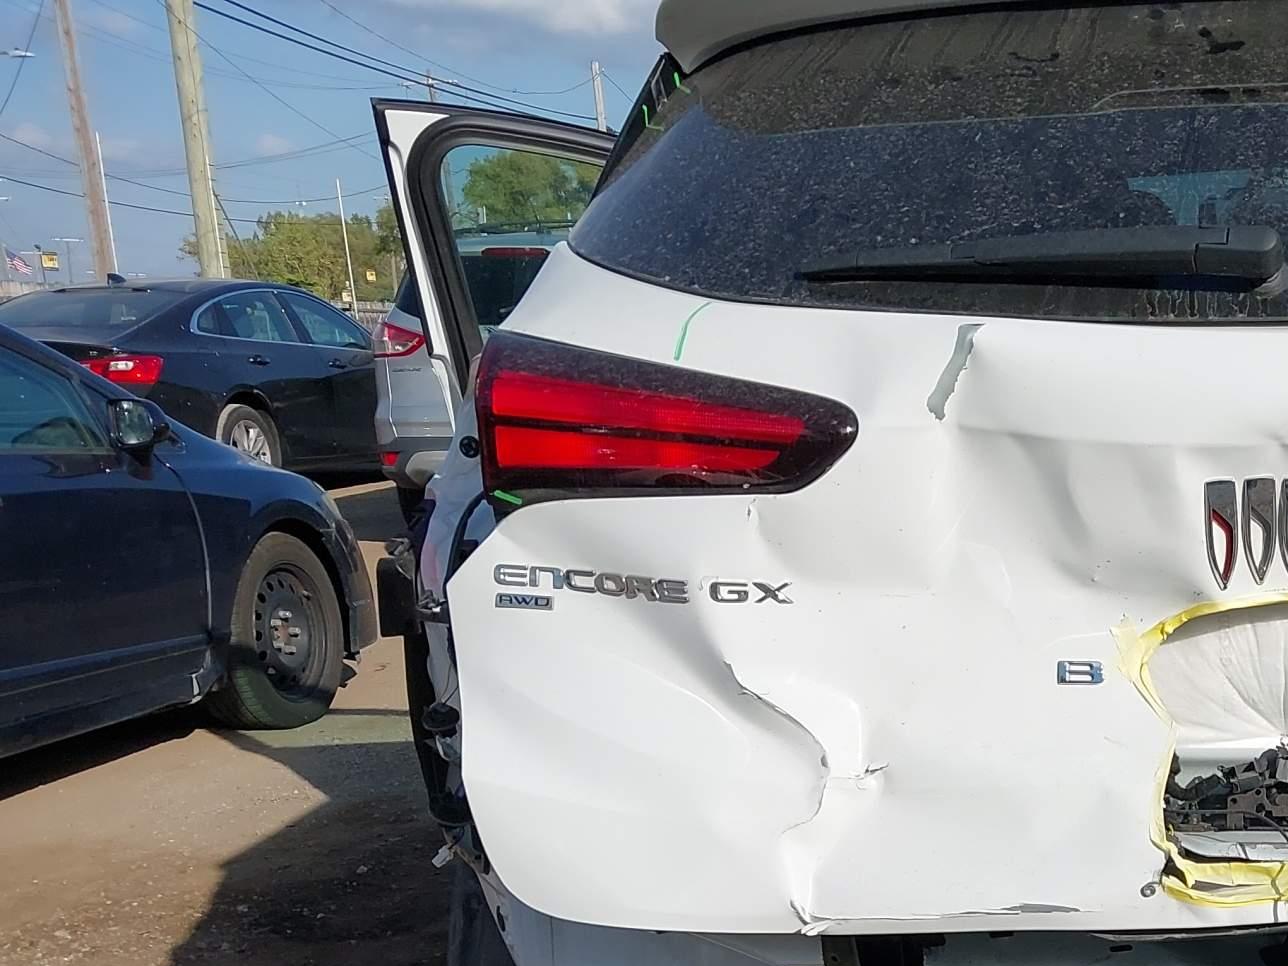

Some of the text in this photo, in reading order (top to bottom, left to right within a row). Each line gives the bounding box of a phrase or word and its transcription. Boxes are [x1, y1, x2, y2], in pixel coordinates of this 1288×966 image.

[498, 594, 551, 608] AWD
[709, 580, 795, 605] GX
[1056, 660, 1104, 686] B
